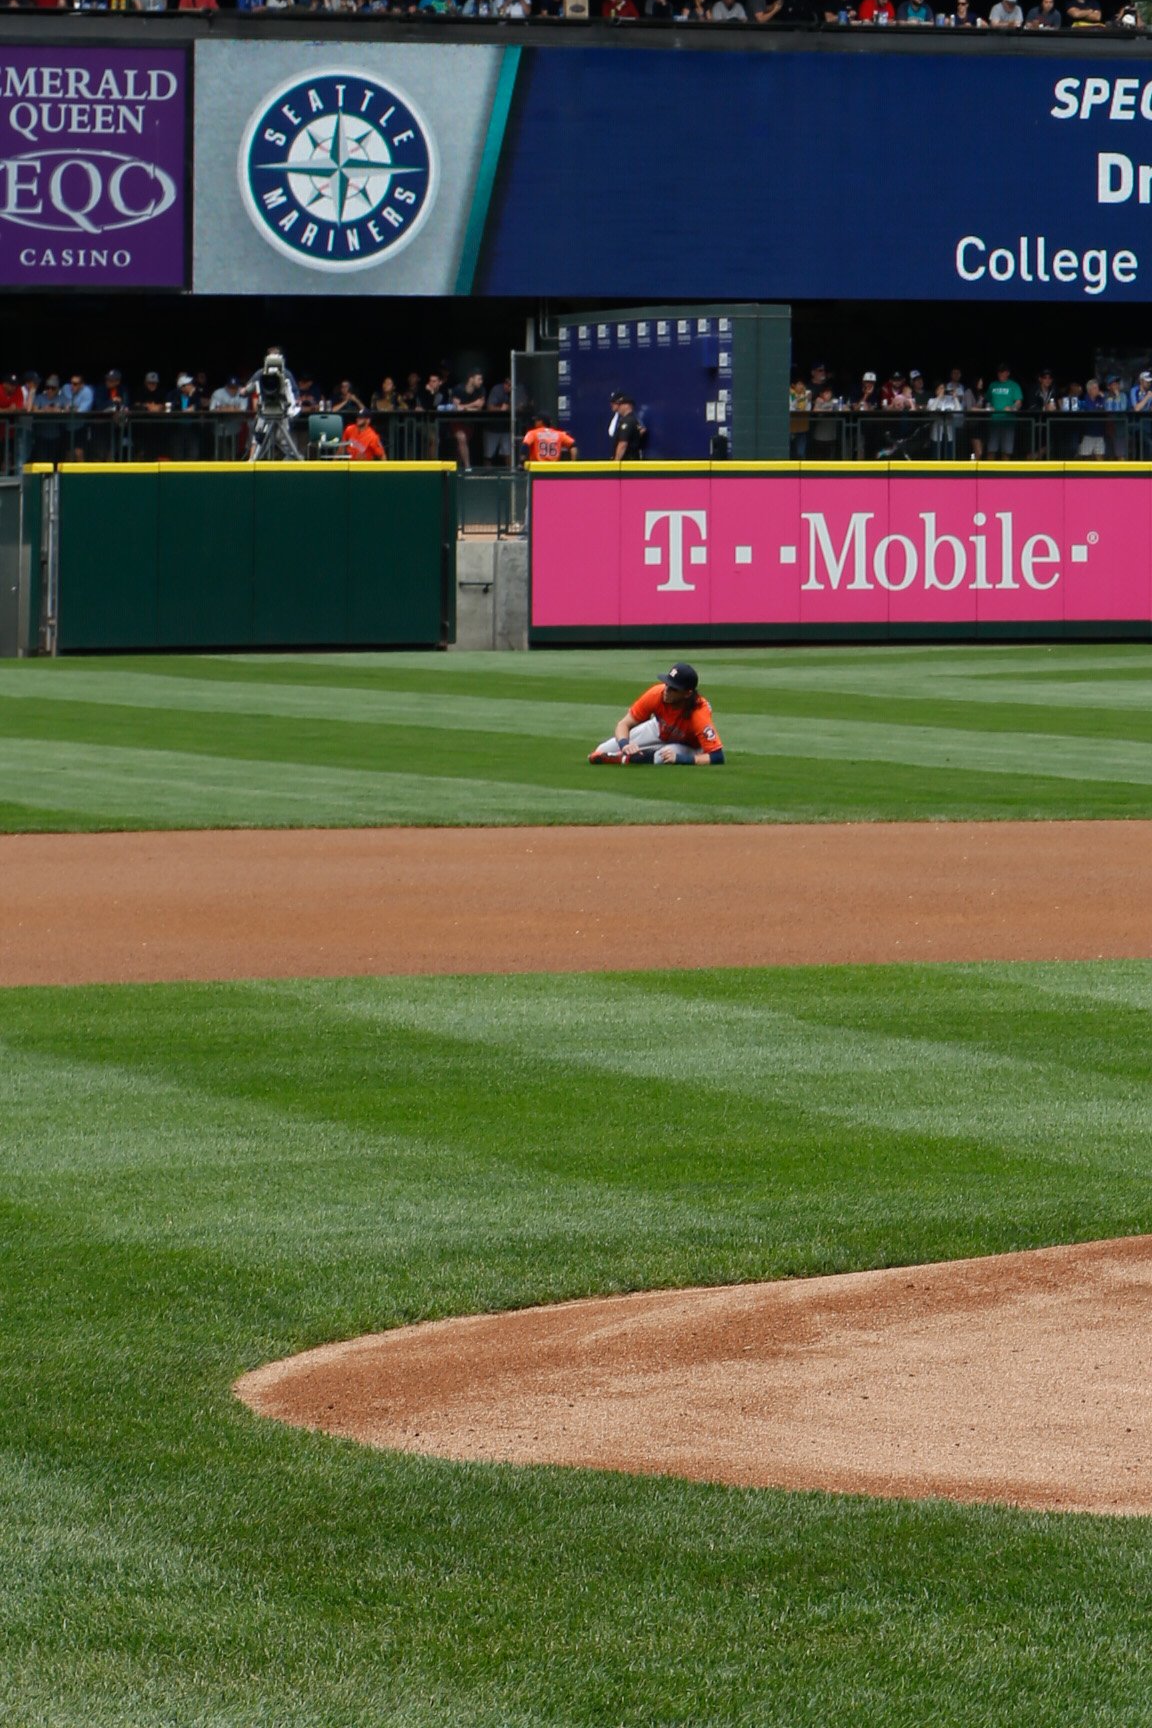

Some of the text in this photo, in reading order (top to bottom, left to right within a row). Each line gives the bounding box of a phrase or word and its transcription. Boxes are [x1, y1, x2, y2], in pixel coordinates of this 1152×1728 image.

[0, 67, 177, 100] MERALD
[9, 102, 146, 141] QUEEN
[264, 84, 415, 147] SEATTLE
[0, 160, 156, 234] EQC
[263, 187, 416, 252] MARINERS
[20, 248, 131, 267] CASINO
[956, 235, 1138, 294] College
